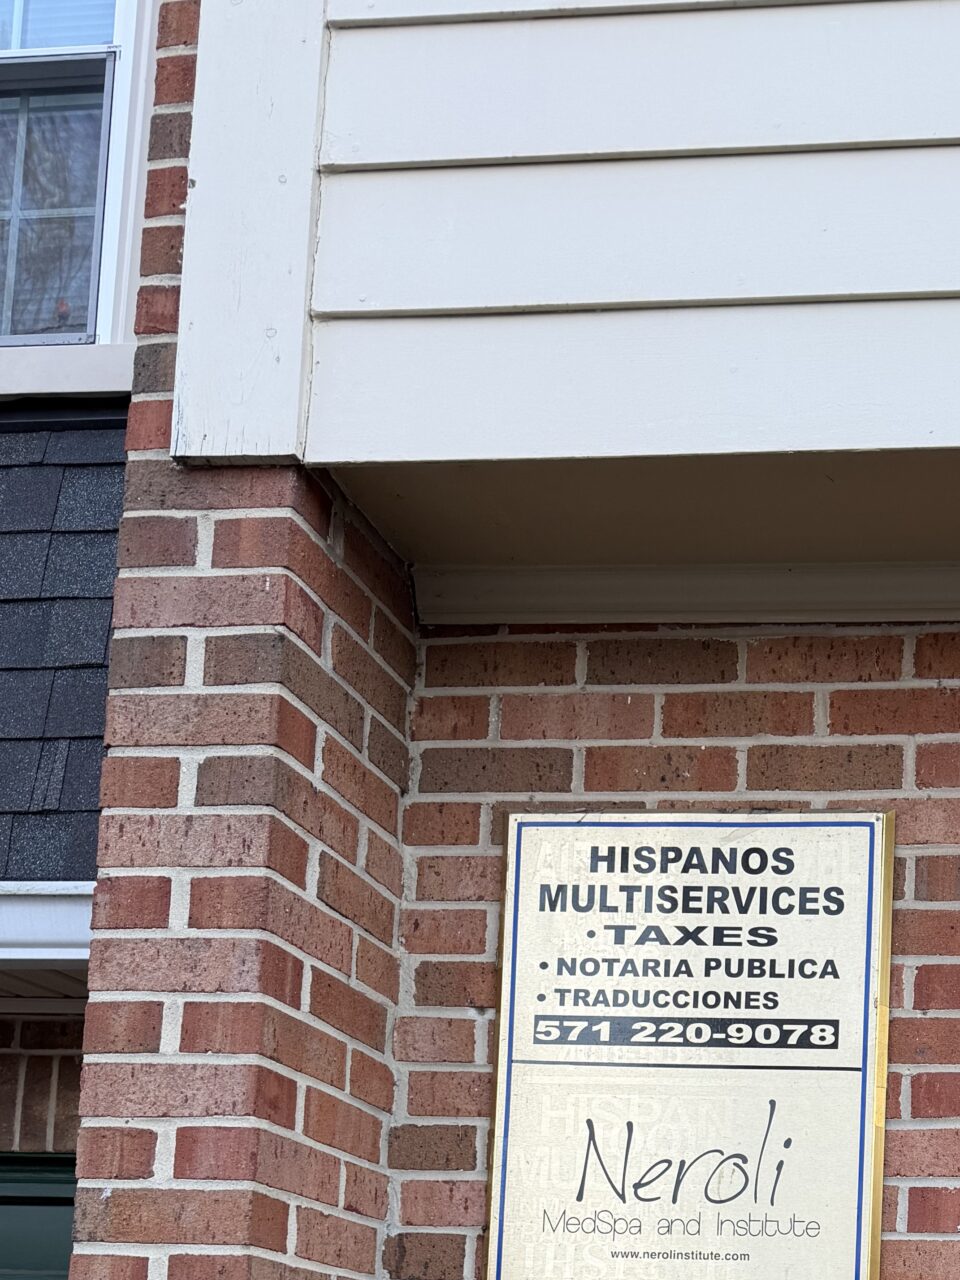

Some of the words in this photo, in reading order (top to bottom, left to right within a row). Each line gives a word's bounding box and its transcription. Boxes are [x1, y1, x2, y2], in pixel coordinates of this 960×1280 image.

[590, 846, 795, 876] HISPANOS
[538, 884, 845, 916] MULTISERVICES
[603, 924, 779, 947] TAXES
[556, 957, 694, 978] NOTARIA
[704, 958, 840, 979] PUBLICA
[554, 988, 779, 1010] TRADUCCIONES
[534, 1020, 612, 1042] 571
[631, 1021, 836, 1046] 220-9078
[575, 1099, 792, 1206] Neroli
[542, 1209, 642, 1241] MedSpa
[656, 1212, 701, 1236] and
[716, 1211, 821, 1238] Institute
[610, 1248, 750, 1262] www.nerolinstitute.com
